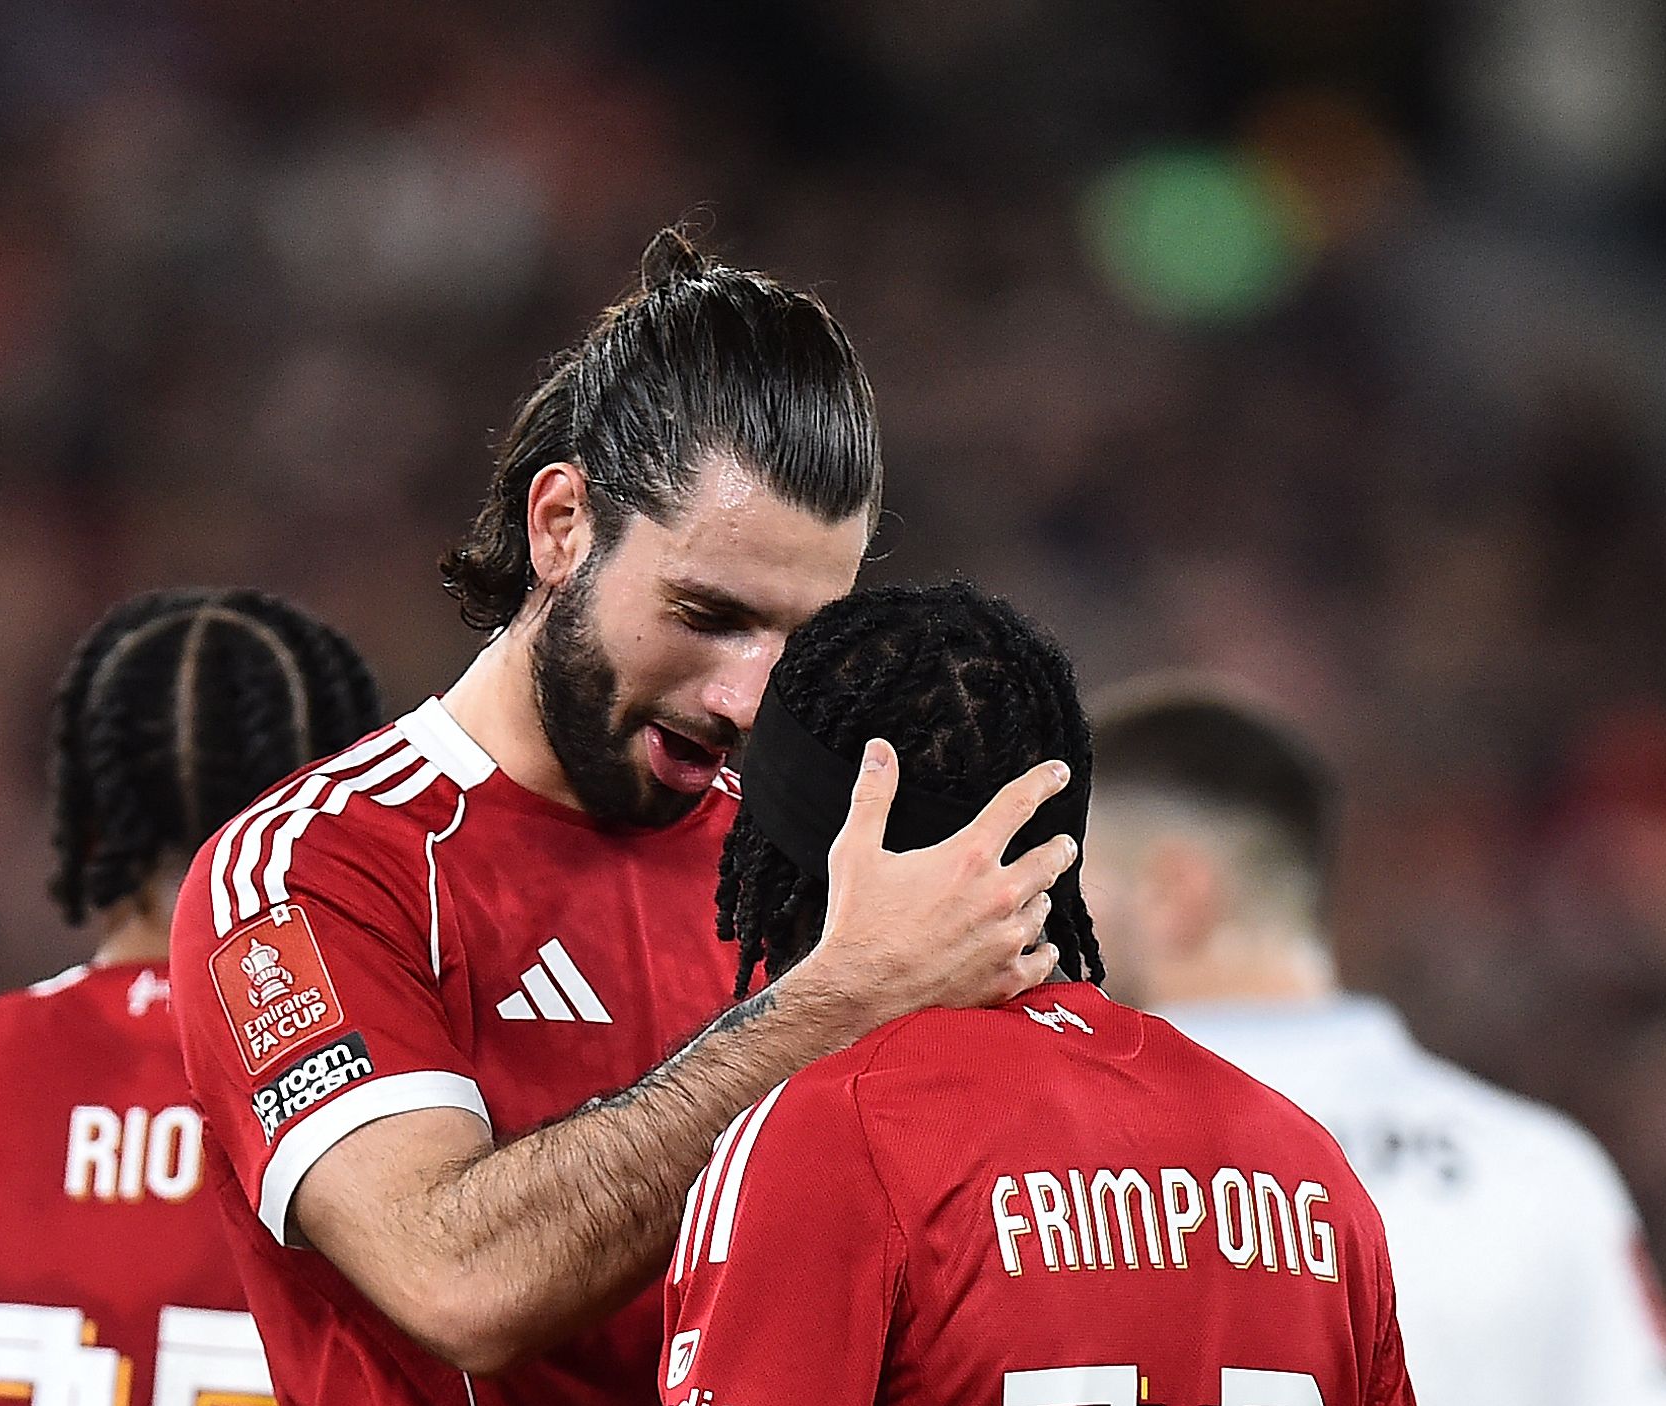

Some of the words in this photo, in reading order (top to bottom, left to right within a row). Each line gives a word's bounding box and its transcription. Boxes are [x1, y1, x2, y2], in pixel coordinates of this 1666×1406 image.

[244, 986, 322, 1040] Emirates
[250, 1031, 279, 1059] FA
[277, 1001, 327, 1038] CUP
[278, 1043, 353, 1100] room
[282, 1056, 373, 1118] racism
[64, 1105, 206, 1203] RIO
[990, 1167, 1339, 1282] FRIMPONG
